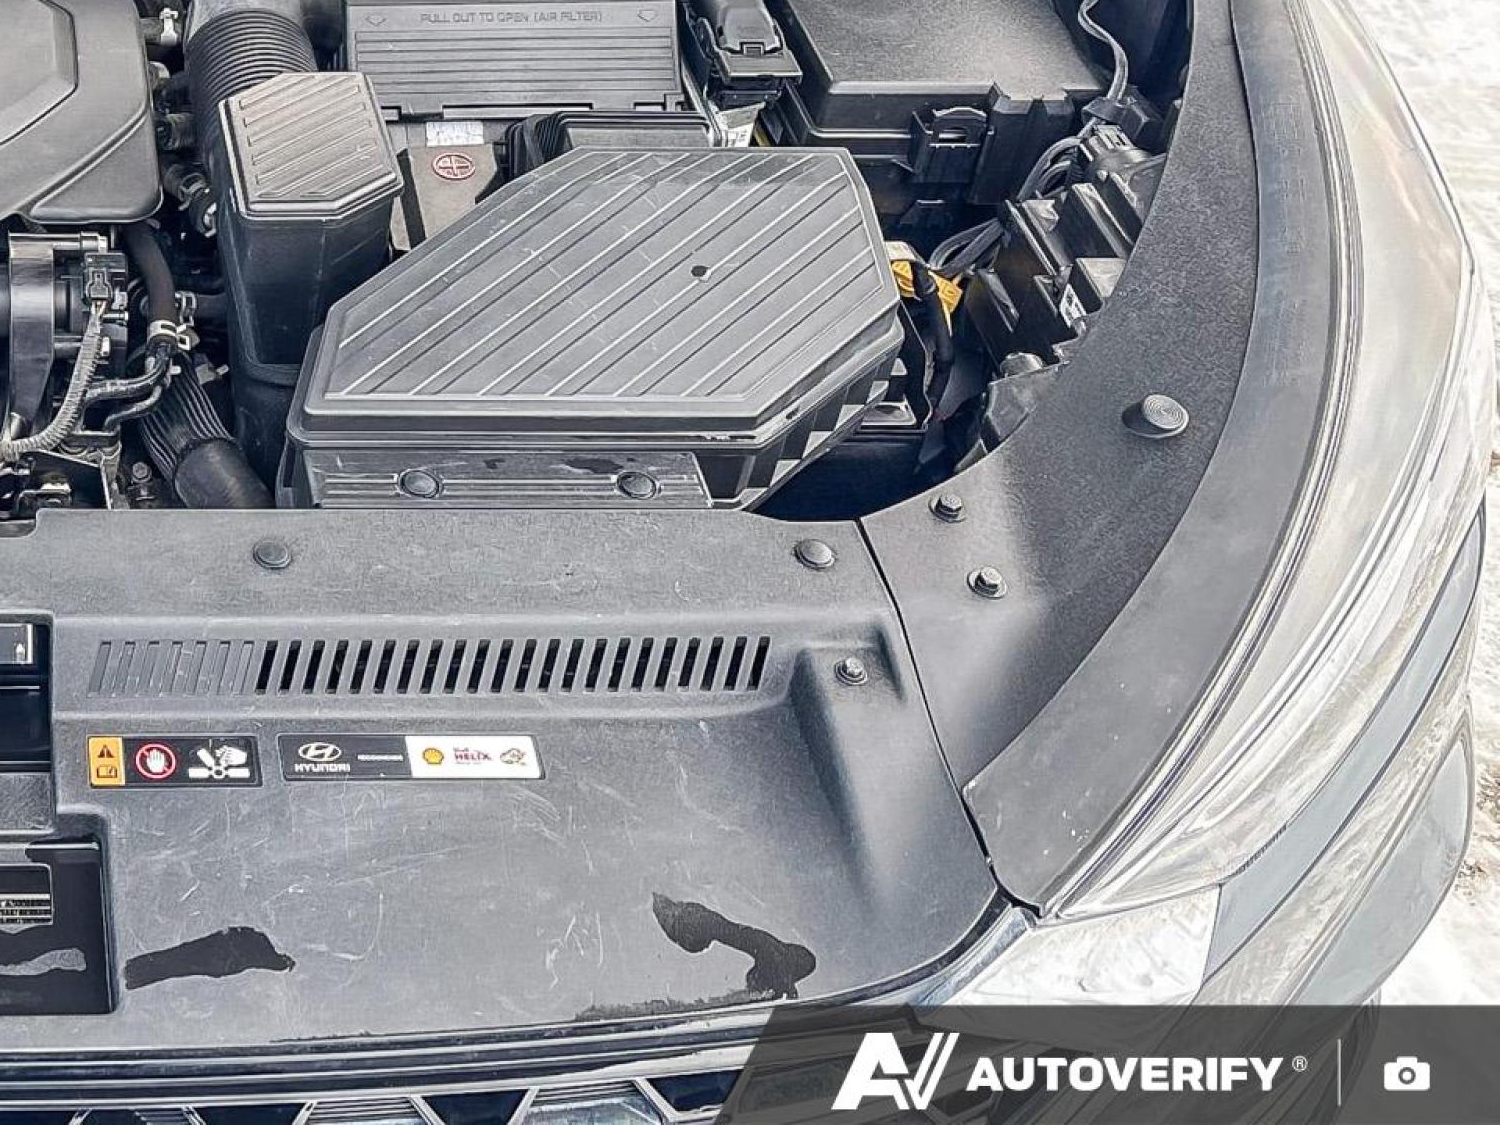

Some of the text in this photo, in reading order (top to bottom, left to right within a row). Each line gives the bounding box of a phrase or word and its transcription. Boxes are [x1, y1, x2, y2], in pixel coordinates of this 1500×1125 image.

[420, 12, 451, 23] PULL
[452, 12, 476, 23] OUT
[478, 12, 494, 23] TO
[497, 12, 529, 23] OPEN
[294, 763, 351, 773] HYUNDAI
